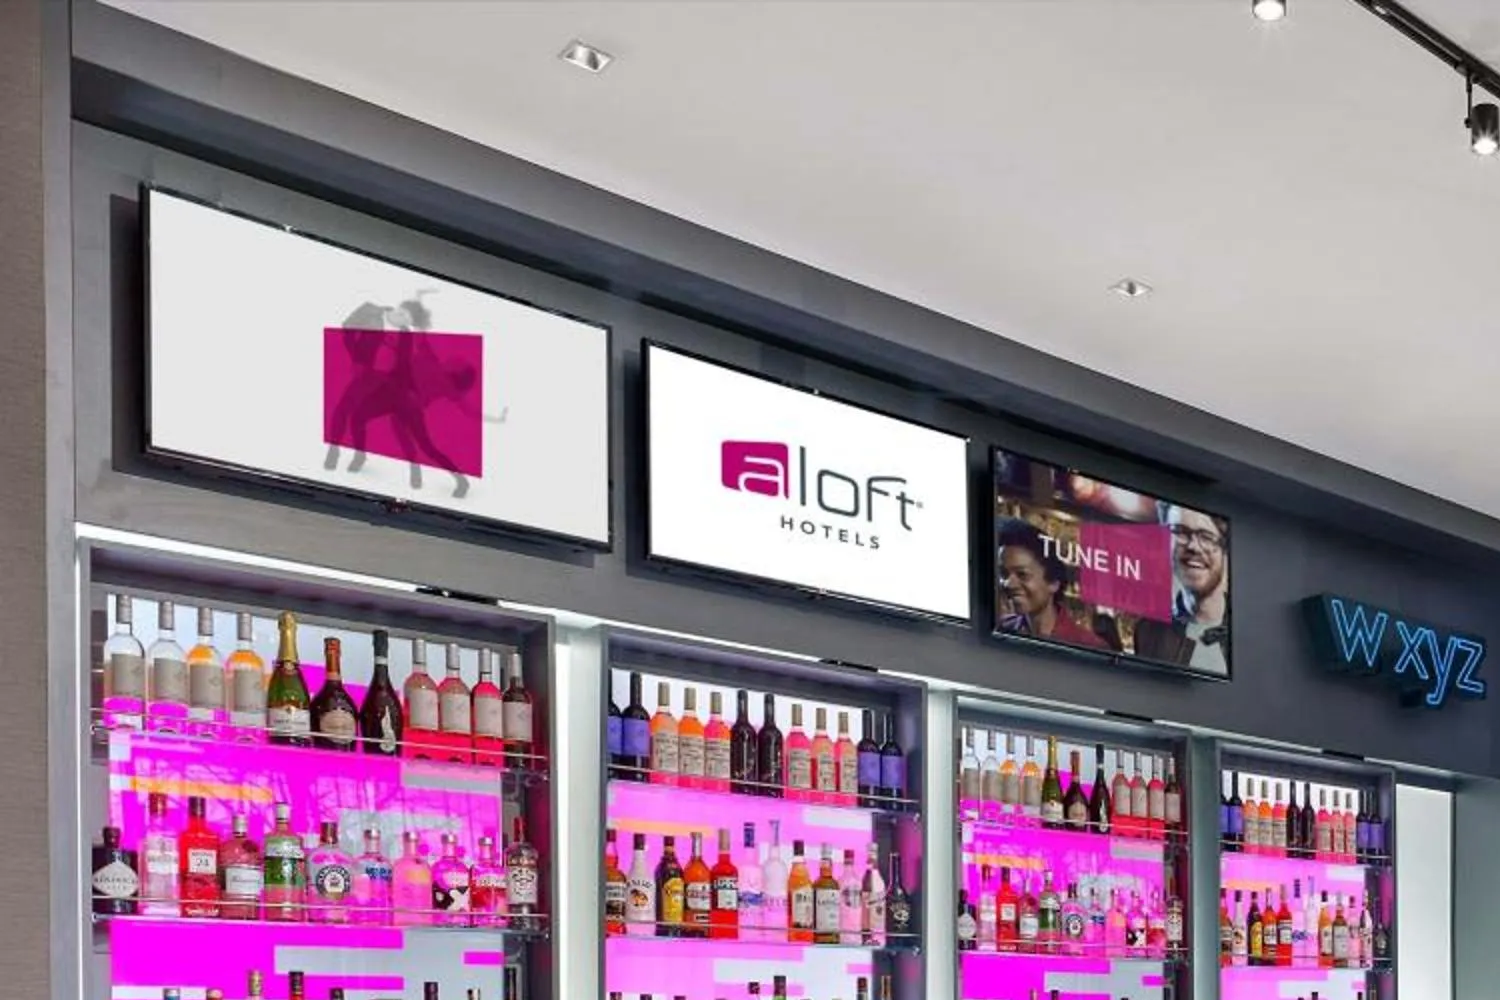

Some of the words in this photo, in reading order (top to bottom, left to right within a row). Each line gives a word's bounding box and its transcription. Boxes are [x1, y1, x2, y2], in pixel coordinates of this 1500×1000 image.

[737, 445, 914, 532] aloft
[780, 514, 881, 550] HOTELS
[1037, 532, 1110, 573] TUNE
[1116, 554, 1142, 581] IN
